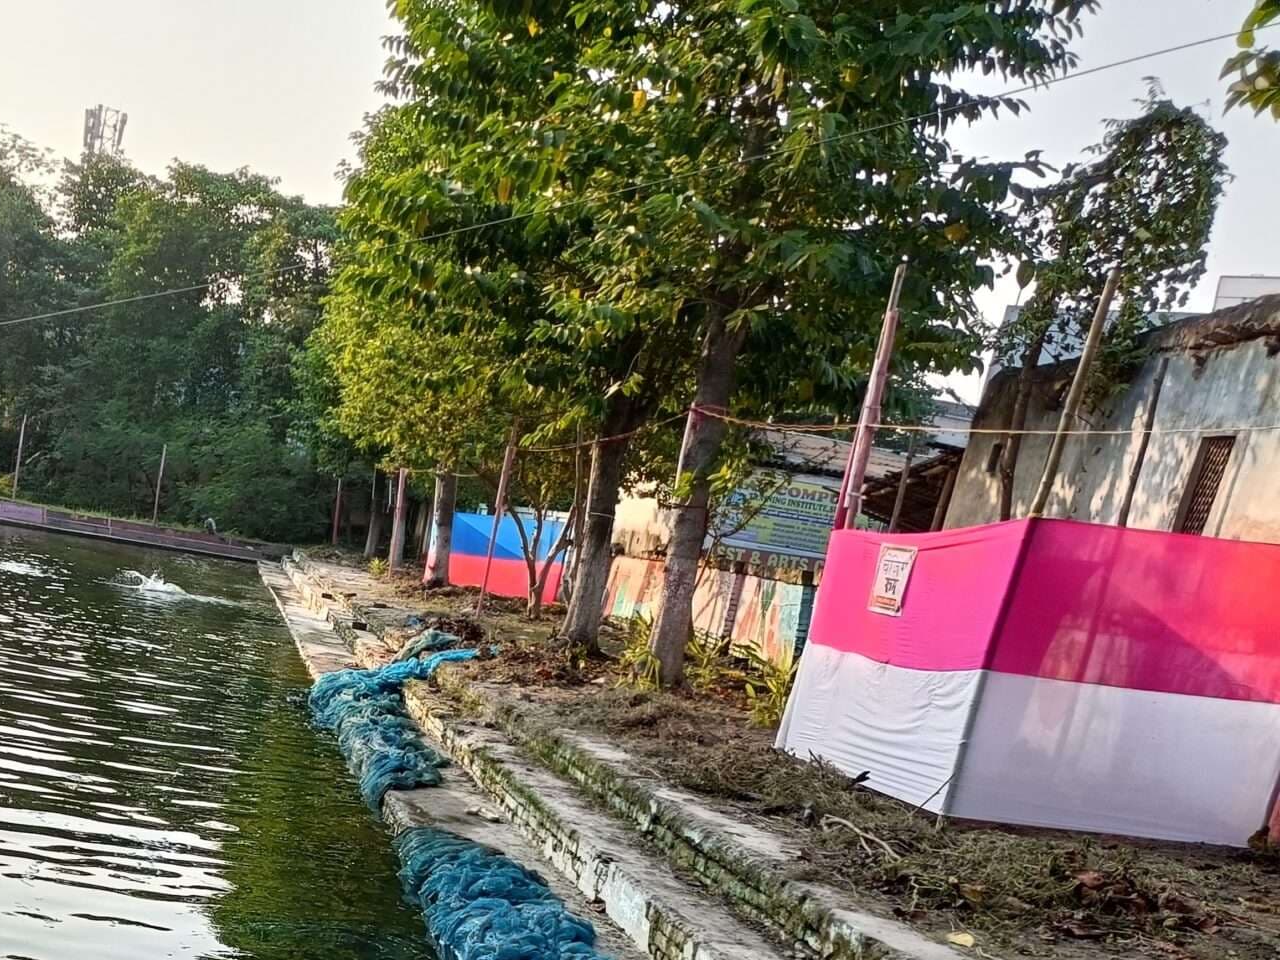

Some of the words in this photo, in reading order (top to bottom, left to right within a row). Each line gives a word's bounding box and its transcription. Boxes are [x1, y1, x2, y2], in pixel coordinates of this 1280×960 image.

[775, 487, 839, 504] COMPU
[751, 551, 761, 566] &
[767, 554, 808, 571] ARTS
